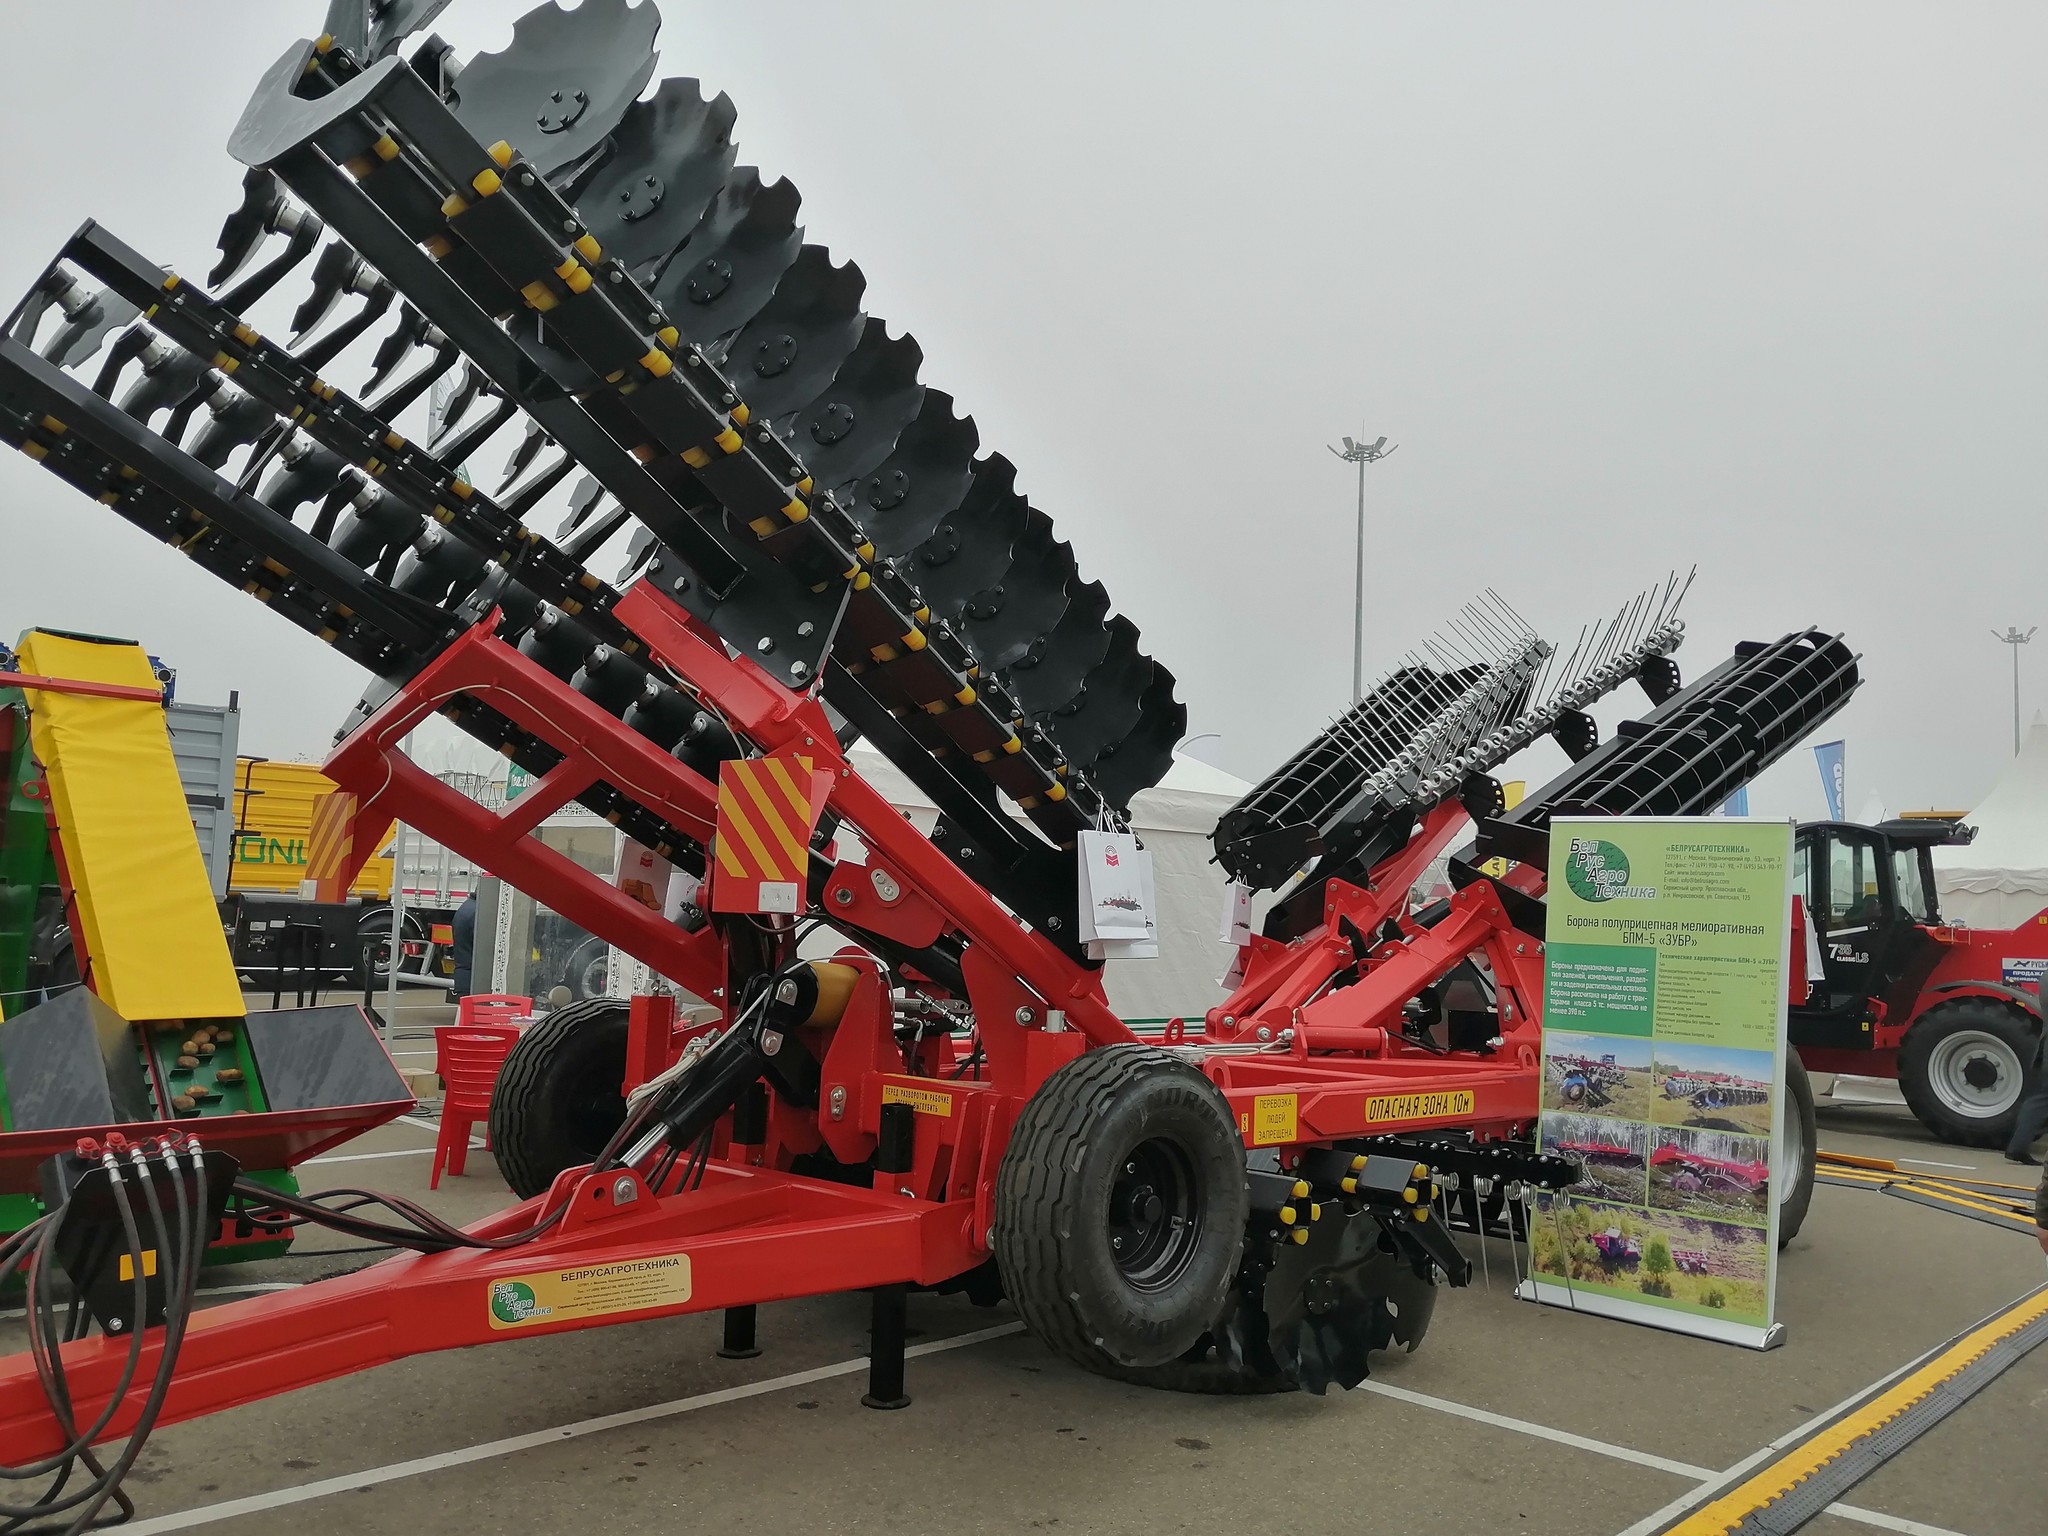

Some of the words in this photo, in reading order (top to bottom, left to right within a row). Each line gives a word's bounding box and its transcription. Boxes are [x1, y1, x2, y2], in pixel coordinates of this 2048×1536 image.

[1570, 837, 1599, 853] Бел
[1666, 845, 1750, 853] «БЕЛРУСАГРОТЕХНИКА»
[1576, 853, 1605, 871] Рус
[1586, 867, 1626, 885] Агро
[1595, 882, 1656, 897] Техника
[1567, 915, 1599, 928] Борона
[1602, 919, 1678, 931] полуприцепная
[1682, 922, 1764, 935] мелиоративная
[1623, 932, 1655, 944] БПМ-5
[1659, 934, 1698, 946] «ЗУБР»
[1694, 955, 1736, 963] характеристики
[1856, 952, 1869, 963] LS
[1608, 993, 1626, 1001] работу
[886, 1088, 898, 1096] ПЕРЕД
[1260, 1099, 1292, 1109] ПЕРЕВОЗКА
[1370, 1097, 1419, 1120] ОПАСНАЯ
[1423, 1095, 1448, 1115] ЗОНА
[1259, 1129, 1292, 1140] ЗАПРЕЩЕНА
[561, 1258, 679, 1281] БЕЛРУСАГРОТЕХНИКА
[494, 1283, 513, 1293] Бел
[499, 1292, 518, 1303] Рус
[507, 1299, 533, 1310] Агро
[513, 1306, 552, 1319] Техника
